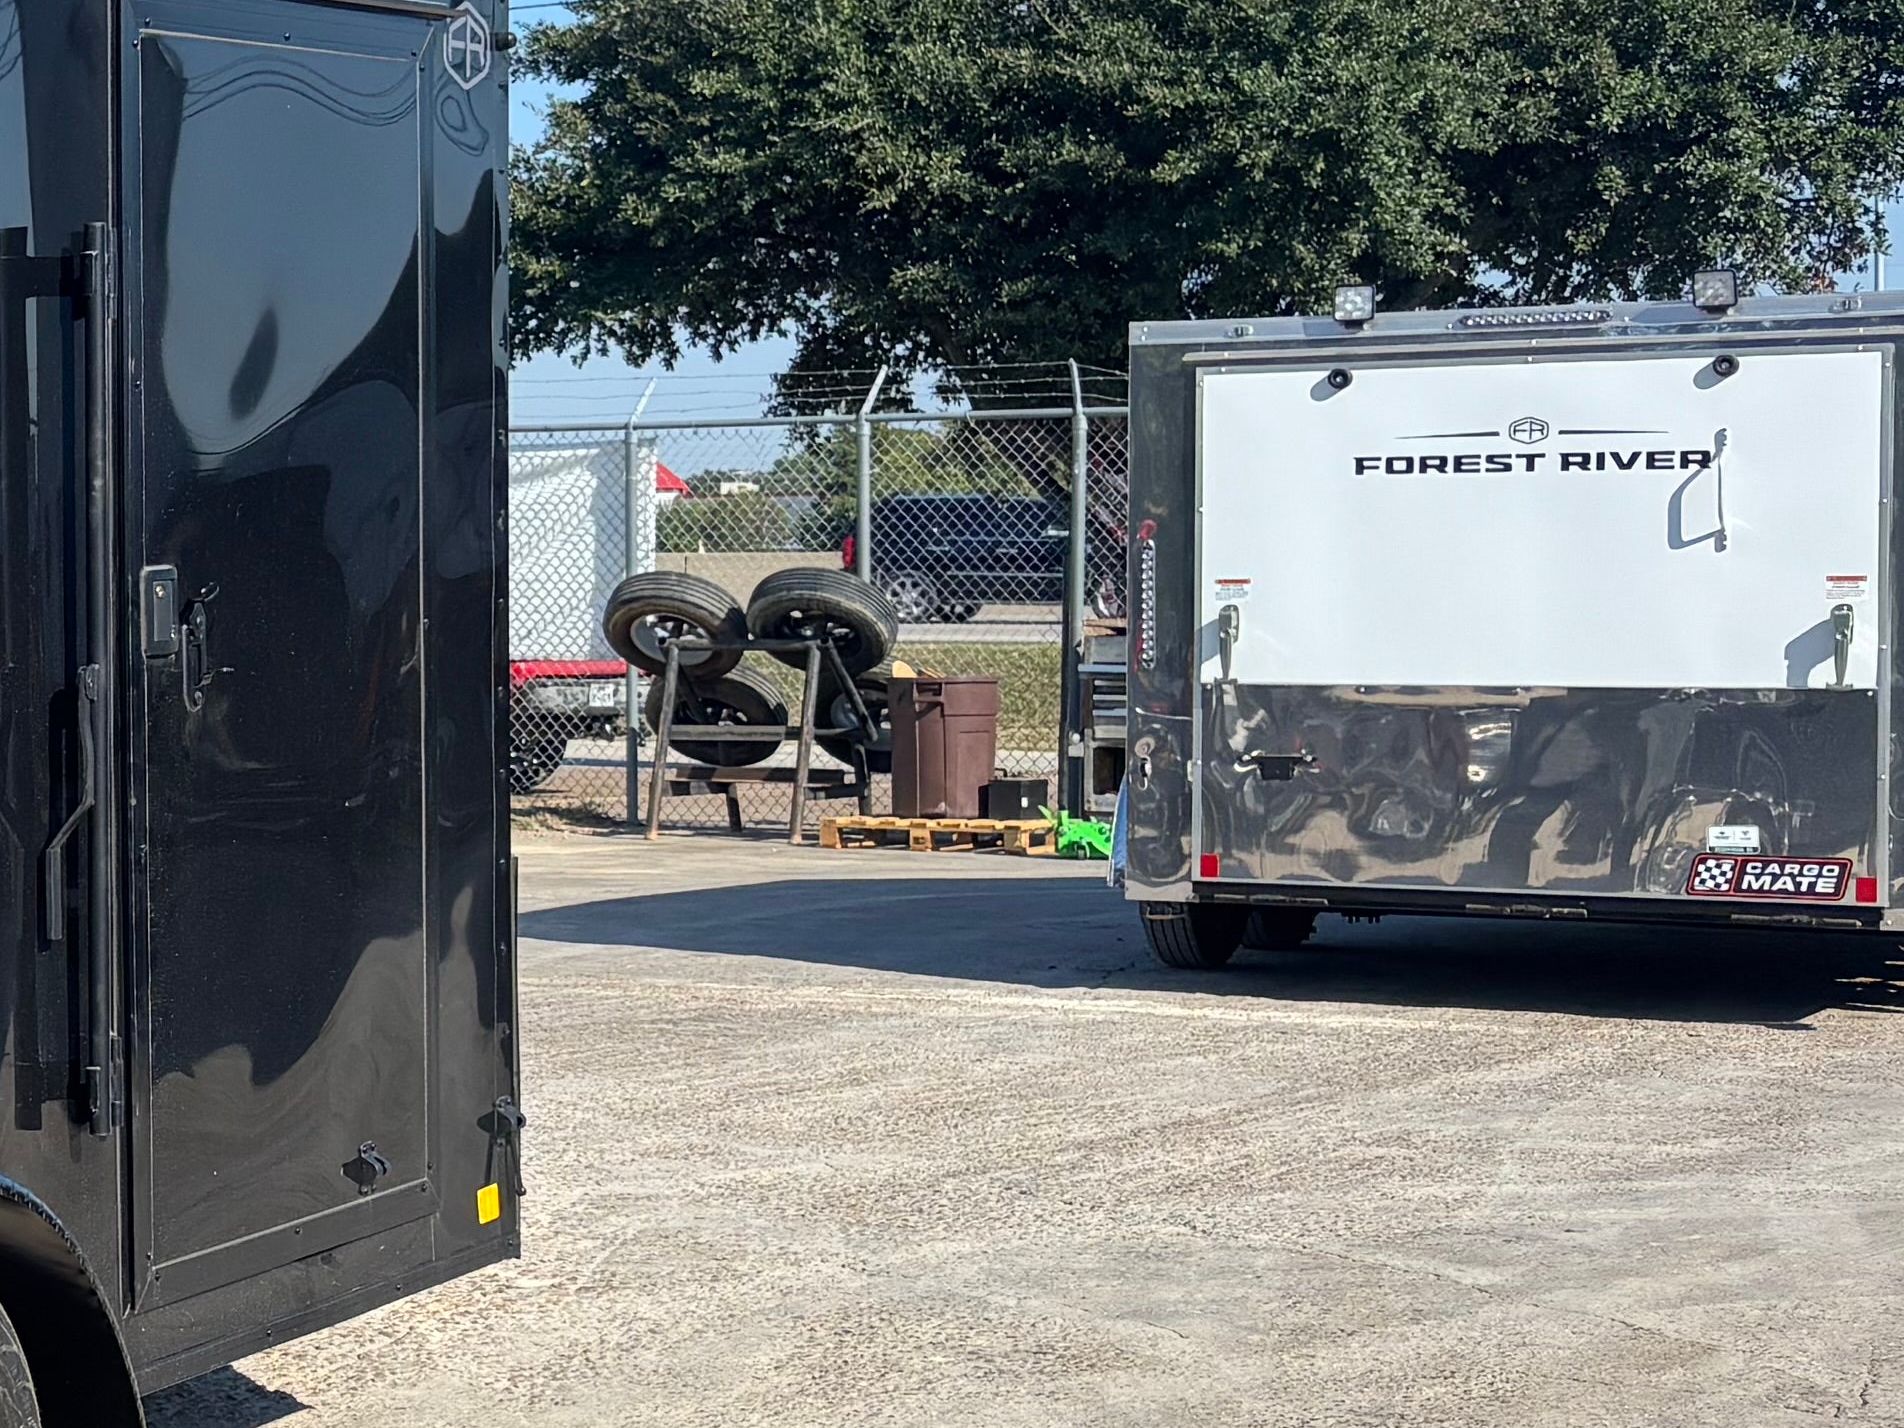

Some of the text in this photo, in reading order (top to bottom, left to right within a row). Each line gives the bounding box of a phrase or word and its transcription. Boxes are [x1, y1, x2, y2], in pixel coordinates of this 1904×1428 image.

[1353, 450, 1712, 476] FOREST RIVER
[1745, 862, 1840, 877] CARGO
[1741, 875, 1838, 893] MATE
